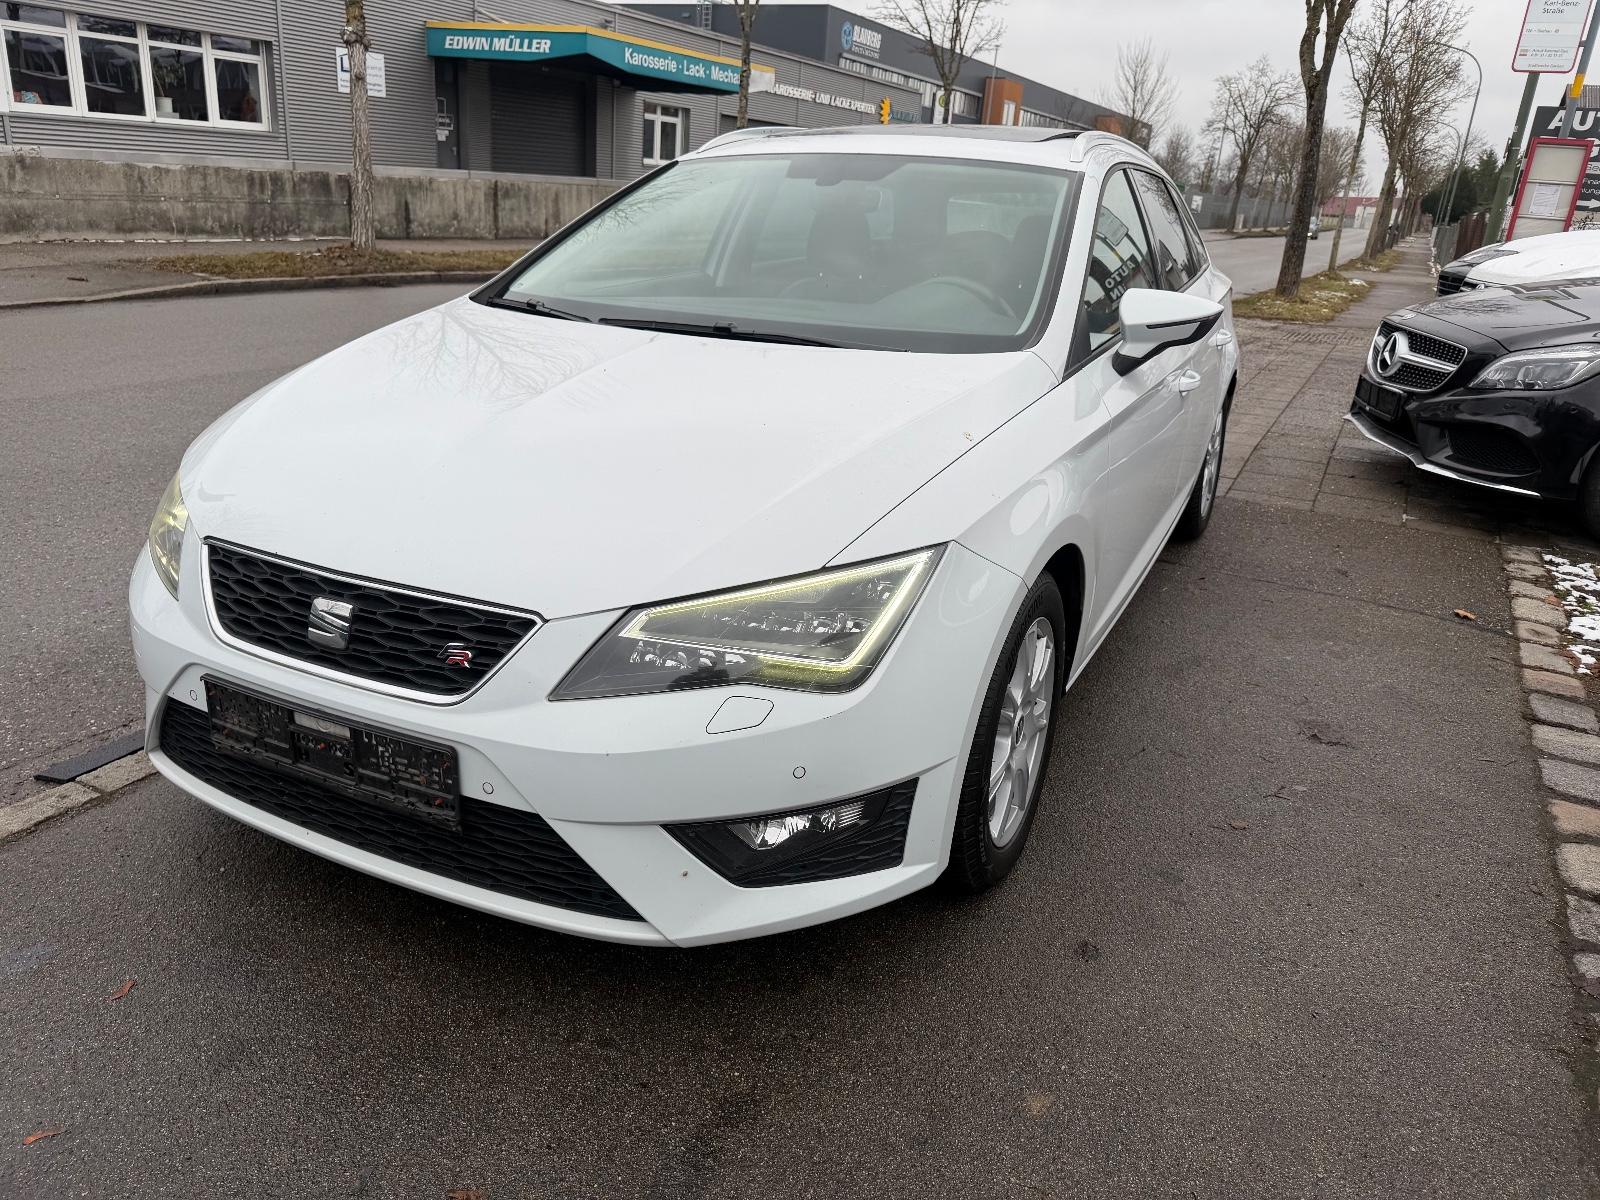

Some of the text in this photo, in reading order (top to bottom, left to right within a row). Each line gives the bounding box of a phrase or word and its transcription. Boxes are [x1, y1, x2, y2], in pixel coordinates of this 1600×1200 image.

[444, 35, 551, 53] EDWIN MÜLLER
[624, 47, 741, 85] Karosserie Lack Mecha
